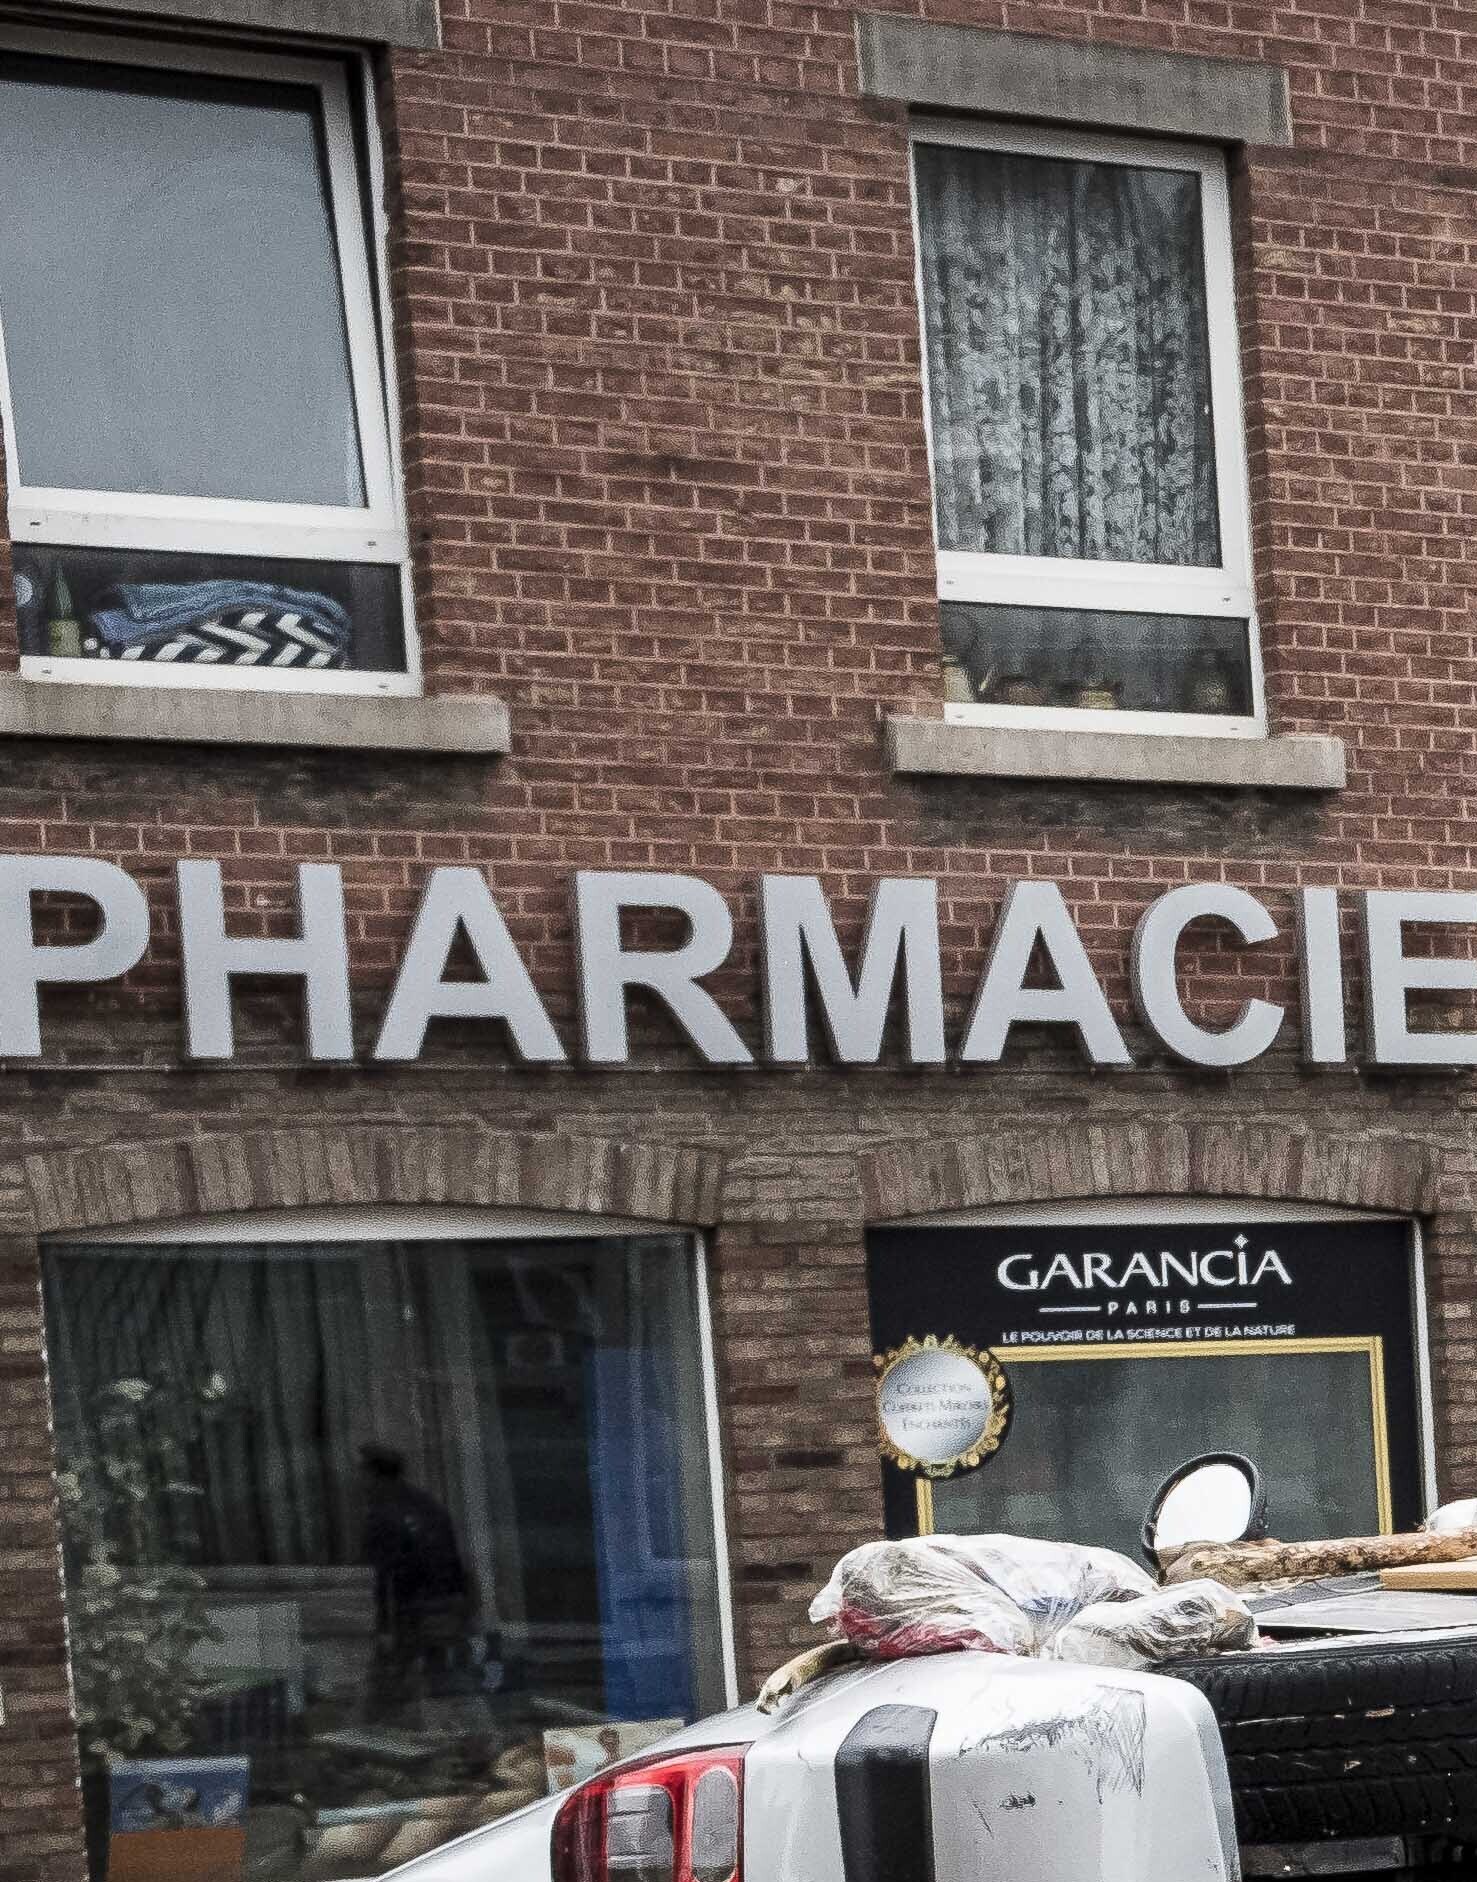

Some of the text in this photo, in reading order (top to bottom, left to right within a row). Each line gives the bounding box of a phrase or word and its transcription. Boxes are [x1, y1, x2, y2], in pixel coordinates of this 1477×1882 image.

[997, 1234, 1293, 1290] GARANCIA
[1107, 1299, 1191, 1316] PARIS
[1002, 1324, 1297, 1344] LE POUVOIR DE LA SCIENCE ET DE LA NATURE
